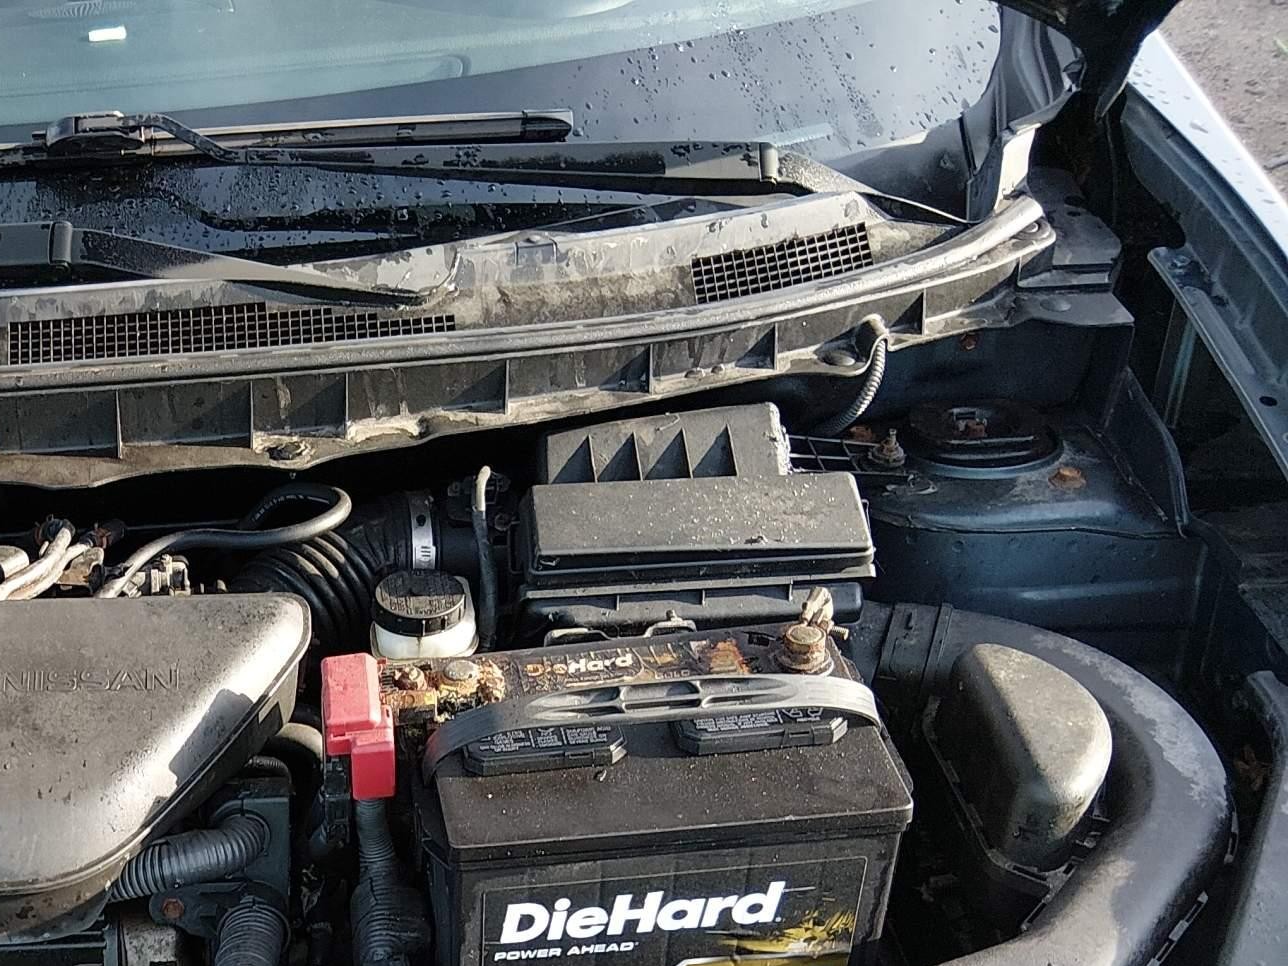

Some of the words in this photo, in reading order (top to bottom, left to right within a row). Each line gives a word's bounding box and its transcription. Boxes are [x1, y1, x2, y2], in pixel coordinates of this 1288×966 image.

[499, 880, 784, 946] DieHard
[494, 946, 561, 962] POWER
[567, 941, 634, 957] AHEAD
